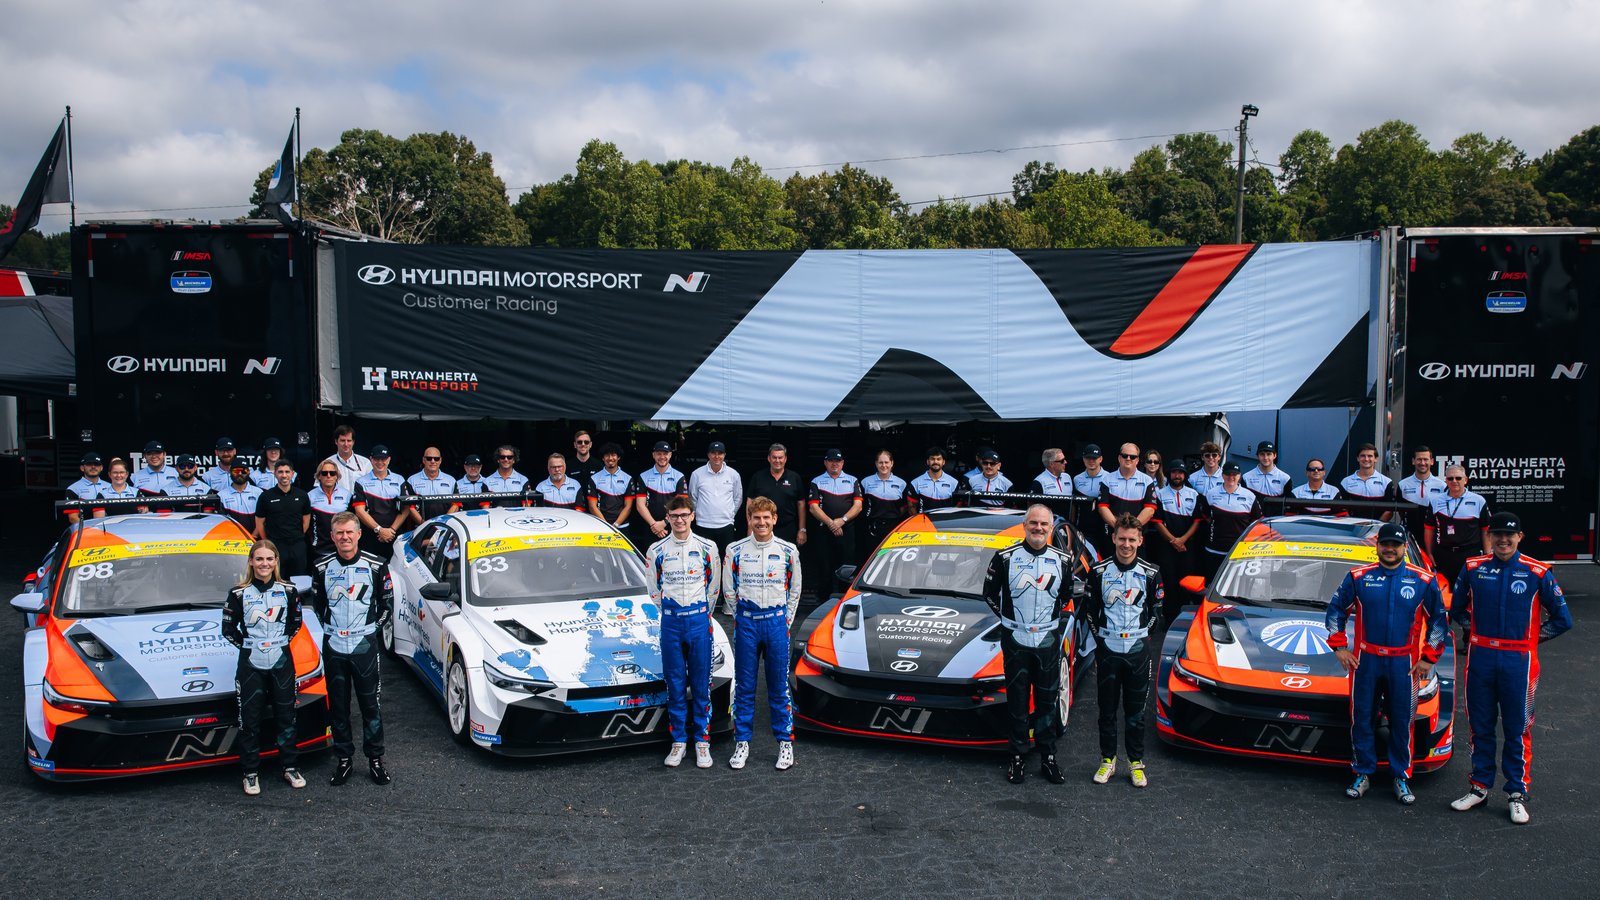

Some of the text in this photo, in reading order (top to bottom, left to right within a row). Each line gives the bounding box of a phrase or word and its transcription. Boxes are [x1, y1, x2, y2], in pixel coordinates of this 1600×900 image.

[183, 251, 211, 261] IMSA
[401, 268, 642, 289] HYUNDAI MOTORSPORT
[1501, 272, 1529, 280] IMSA
[402, 292, 558, 315] Customer Racing
[144, 358, 226, 372] HYUNDAI
[391, 370, 478, 382] BRYAN HERTA
[1455, 364, 1535, 378] HYUNDAI
[391, 380, 478, 391] AUTOSPORT
[1469, 457, 1566, 468] BRYAN HERTA
[1469, 468, 1566, 479] AUTOSPORT
[479, 546, 513, 554] HYUNDAI
[890, 548, 919, 562] 76
[78, 554, 116, 563] HYUNDAI
[476, 556, 509, 574] 33
[1237, 560, 1262, 576] 18
[78, 562, 114, 581] 98
[664, 570, 686, 578] Hyundai
[544, 618, 604, 628] Hyundai
[548, 625, 588, 635] Hope
[606, 620, 660, 628] Wheels
[880, 618, 966, 631] HYUNDAI
[877, 626, 963, 637] MOTORSPORT
[922, 635, 952, 644] Racing
[140, 641, 232, 655] MOTORSPOR
[149, 654, 198, 662] Customer
